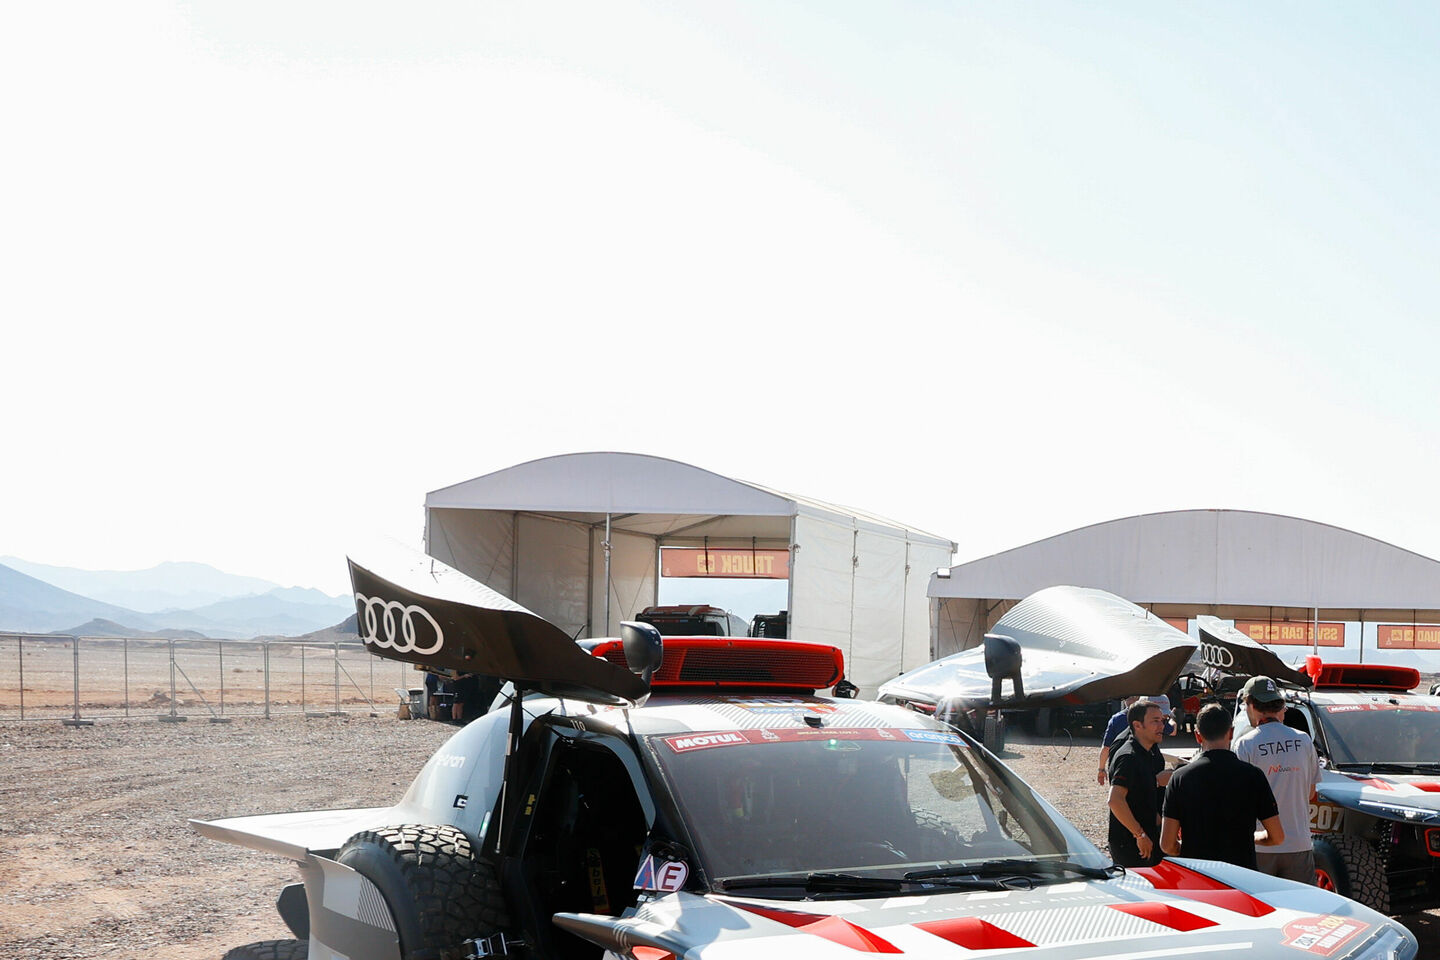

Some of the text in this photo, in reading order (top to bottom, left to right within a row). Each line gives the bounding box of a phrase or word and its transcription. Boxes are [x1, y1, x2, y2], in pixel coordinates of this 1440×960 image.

[675, 733, 742, 749] MOTUL
[909, 731, 962, 744] aramco
[1258, 739, 1302, 757] STAFF
[1308, 803, 1345, 831] 207
[661, 865, 682, 890] E
